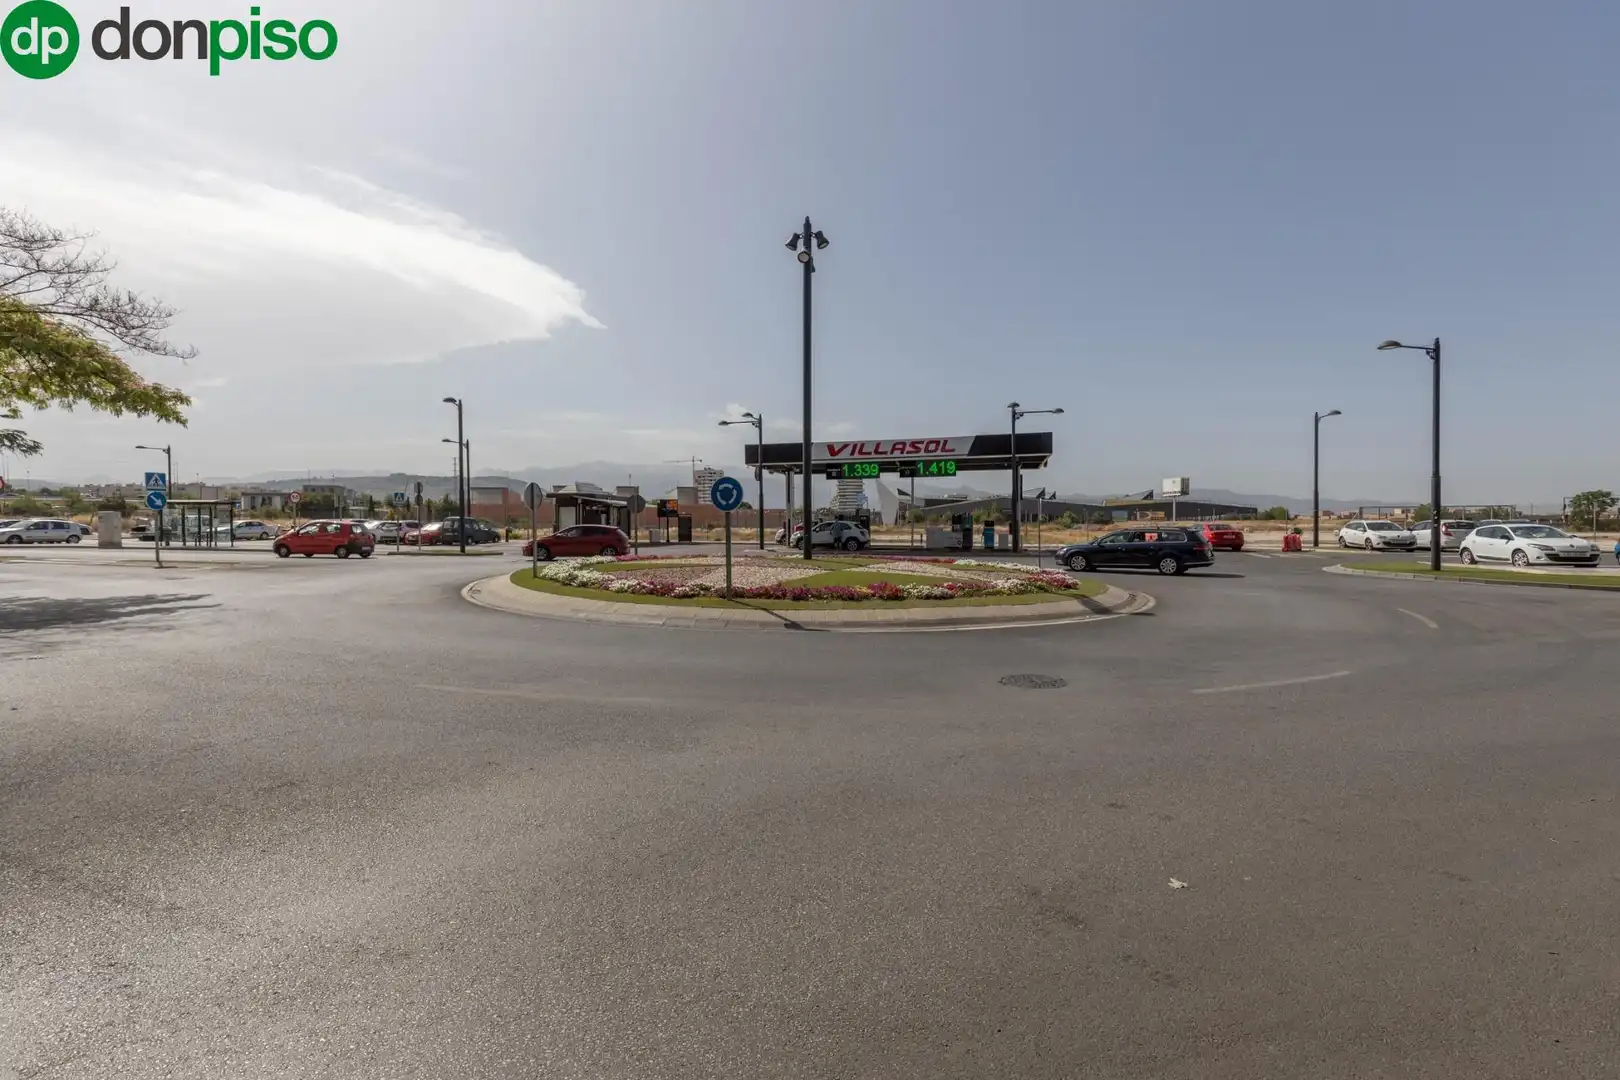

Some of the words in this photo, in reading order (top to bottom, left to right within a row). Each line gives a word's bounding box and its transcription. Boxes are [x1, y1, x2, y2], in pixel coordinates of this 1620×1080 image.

[826, 440, 956, 457] VILLASOL
[842, 463, 879, 477] 1.339
[917, 460, 956, 475] 1.419
